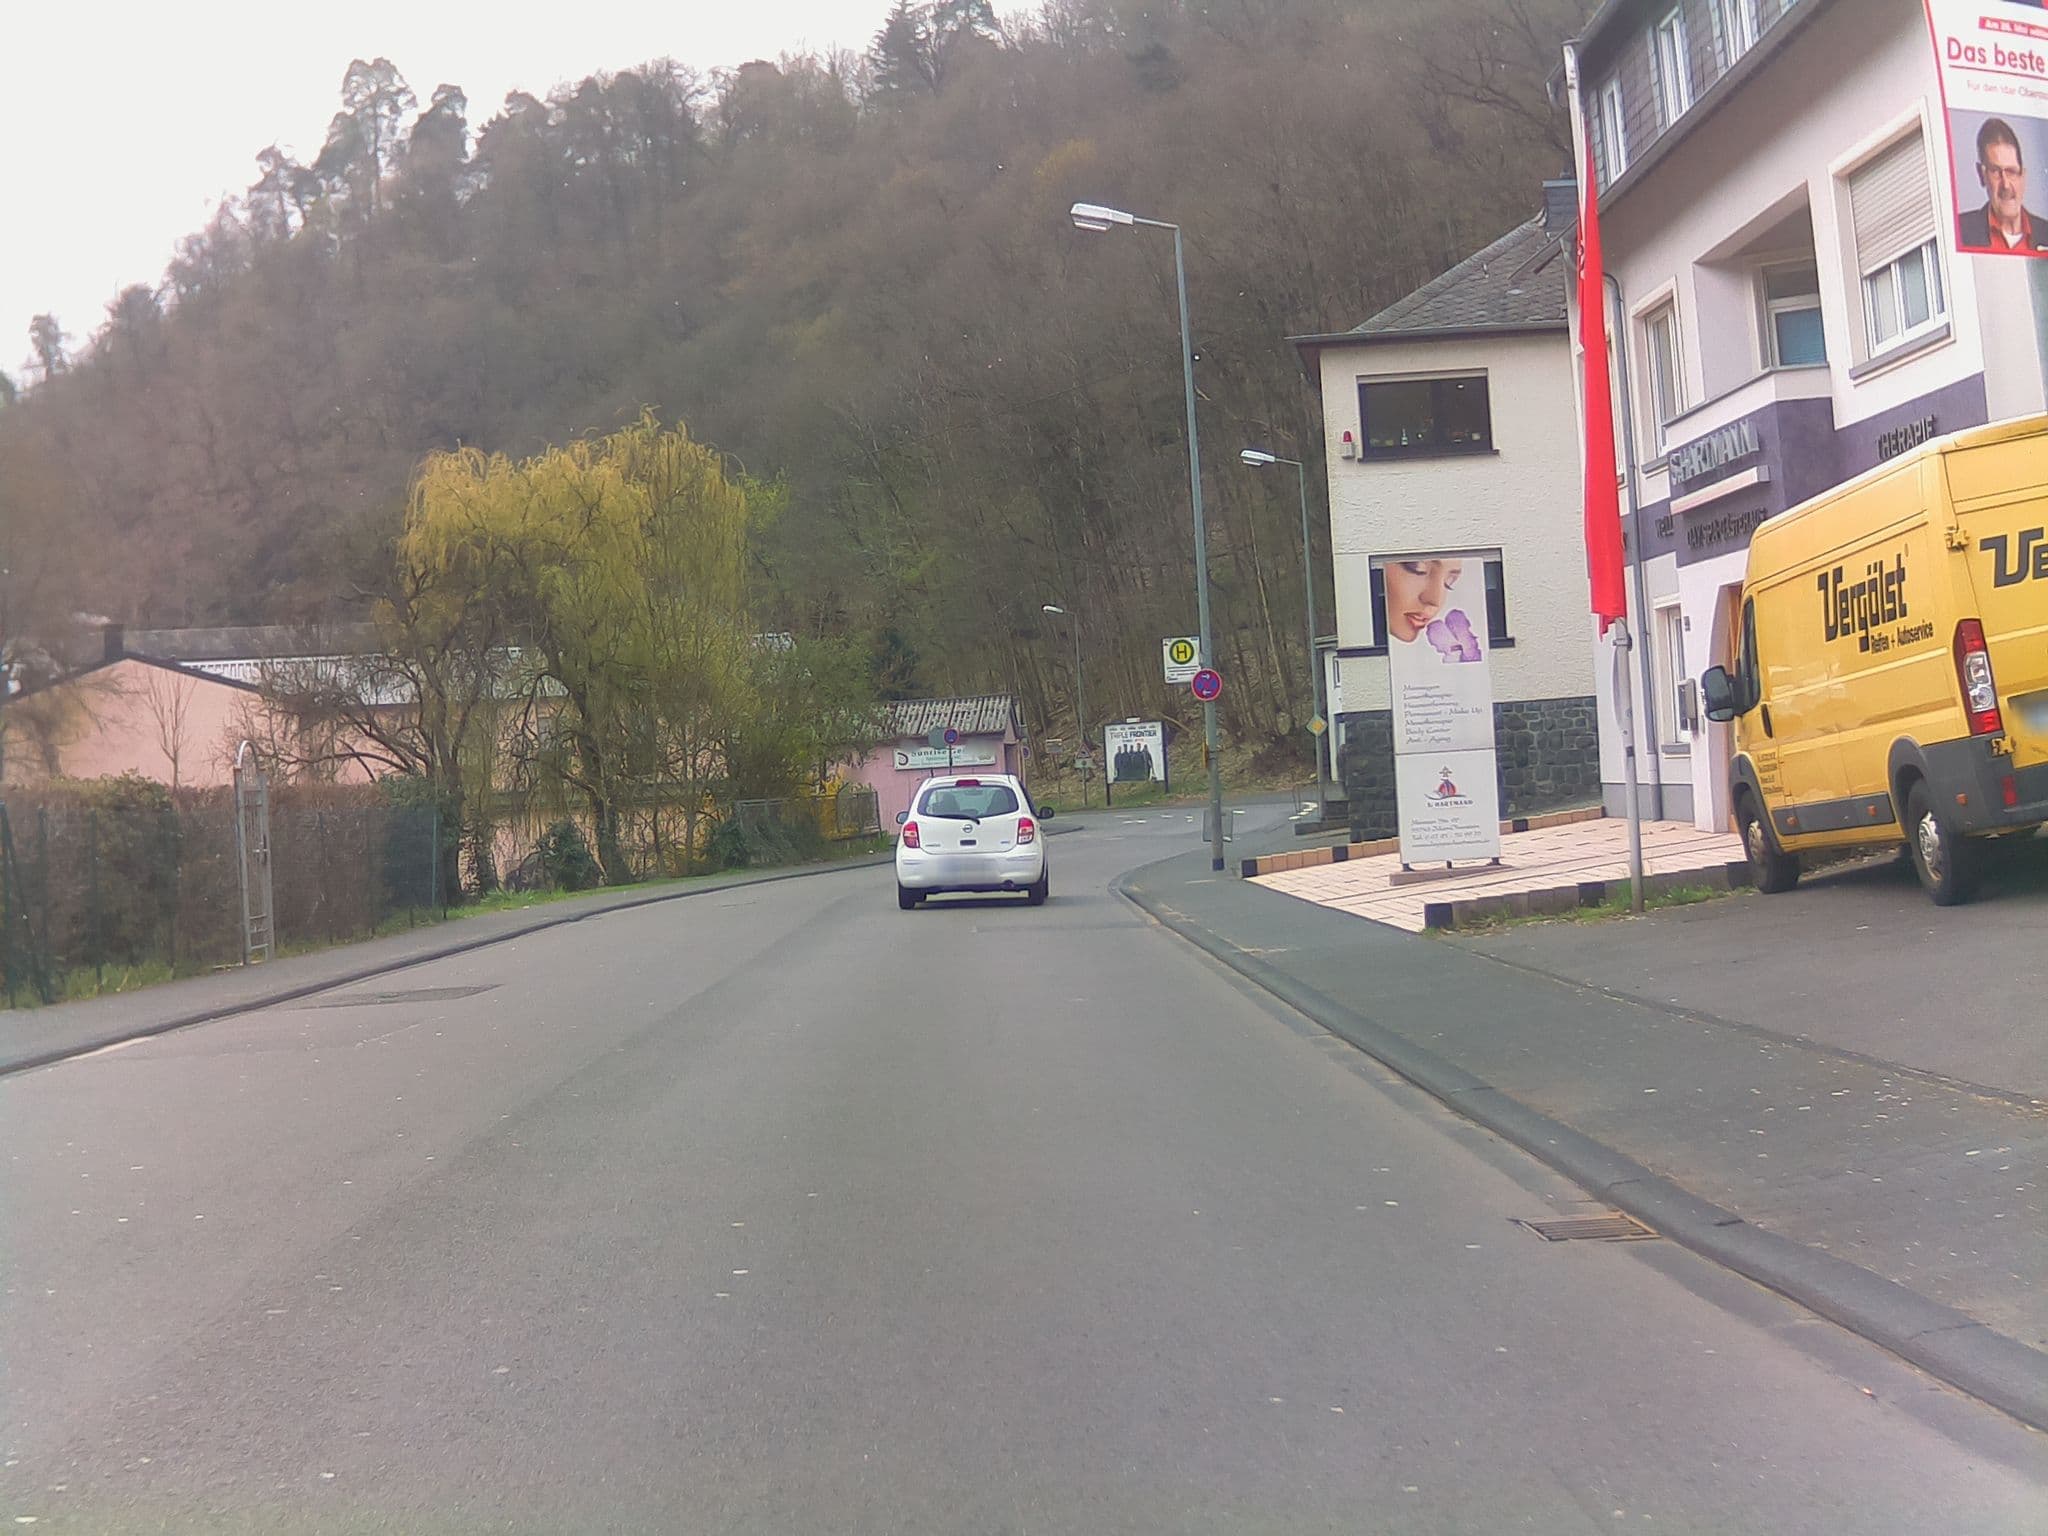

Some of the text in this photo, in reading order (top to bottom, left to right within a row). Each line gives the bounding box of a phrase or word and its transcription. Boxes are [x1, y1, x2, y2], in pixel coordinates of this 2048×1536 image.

[1947, 36, 2045, 74] Das beste
[1817, 552, 1908, 653] Vergölst
[1897, 619, 1934, 648] Autoservice
[1176, 645, 1188, 660] H
